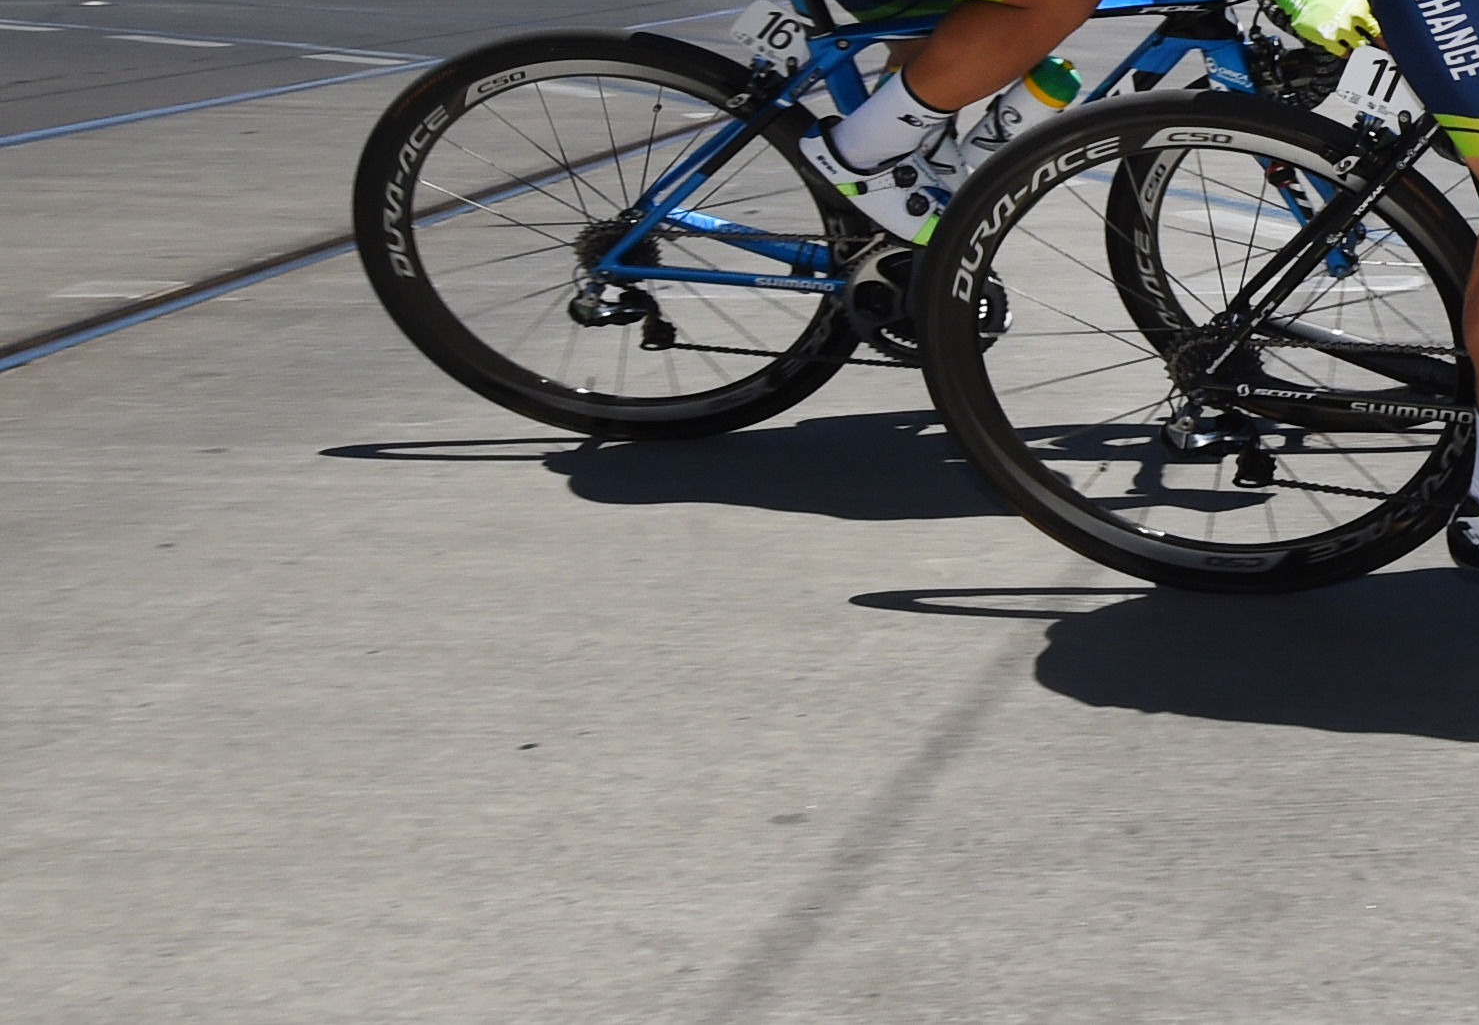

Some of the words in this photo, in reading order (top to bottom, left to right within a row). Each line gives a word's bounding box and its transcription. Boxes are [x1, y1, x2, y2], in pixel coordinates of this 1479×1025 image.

[756, 11, 800, 51] 16
[1366, 59, 1402, 104] 11
[383, 104, 450, 279] DURA-ACE
[1353, 183, 1387, 217] TOPEAK
[951, 135, 1121, 304] DURA-ACE
[753, 275, 836, 293] SHIMANO
[1253, 387, 1318, 401] SCOTT
[1350, 401, 1474, 425] SHIMANO
